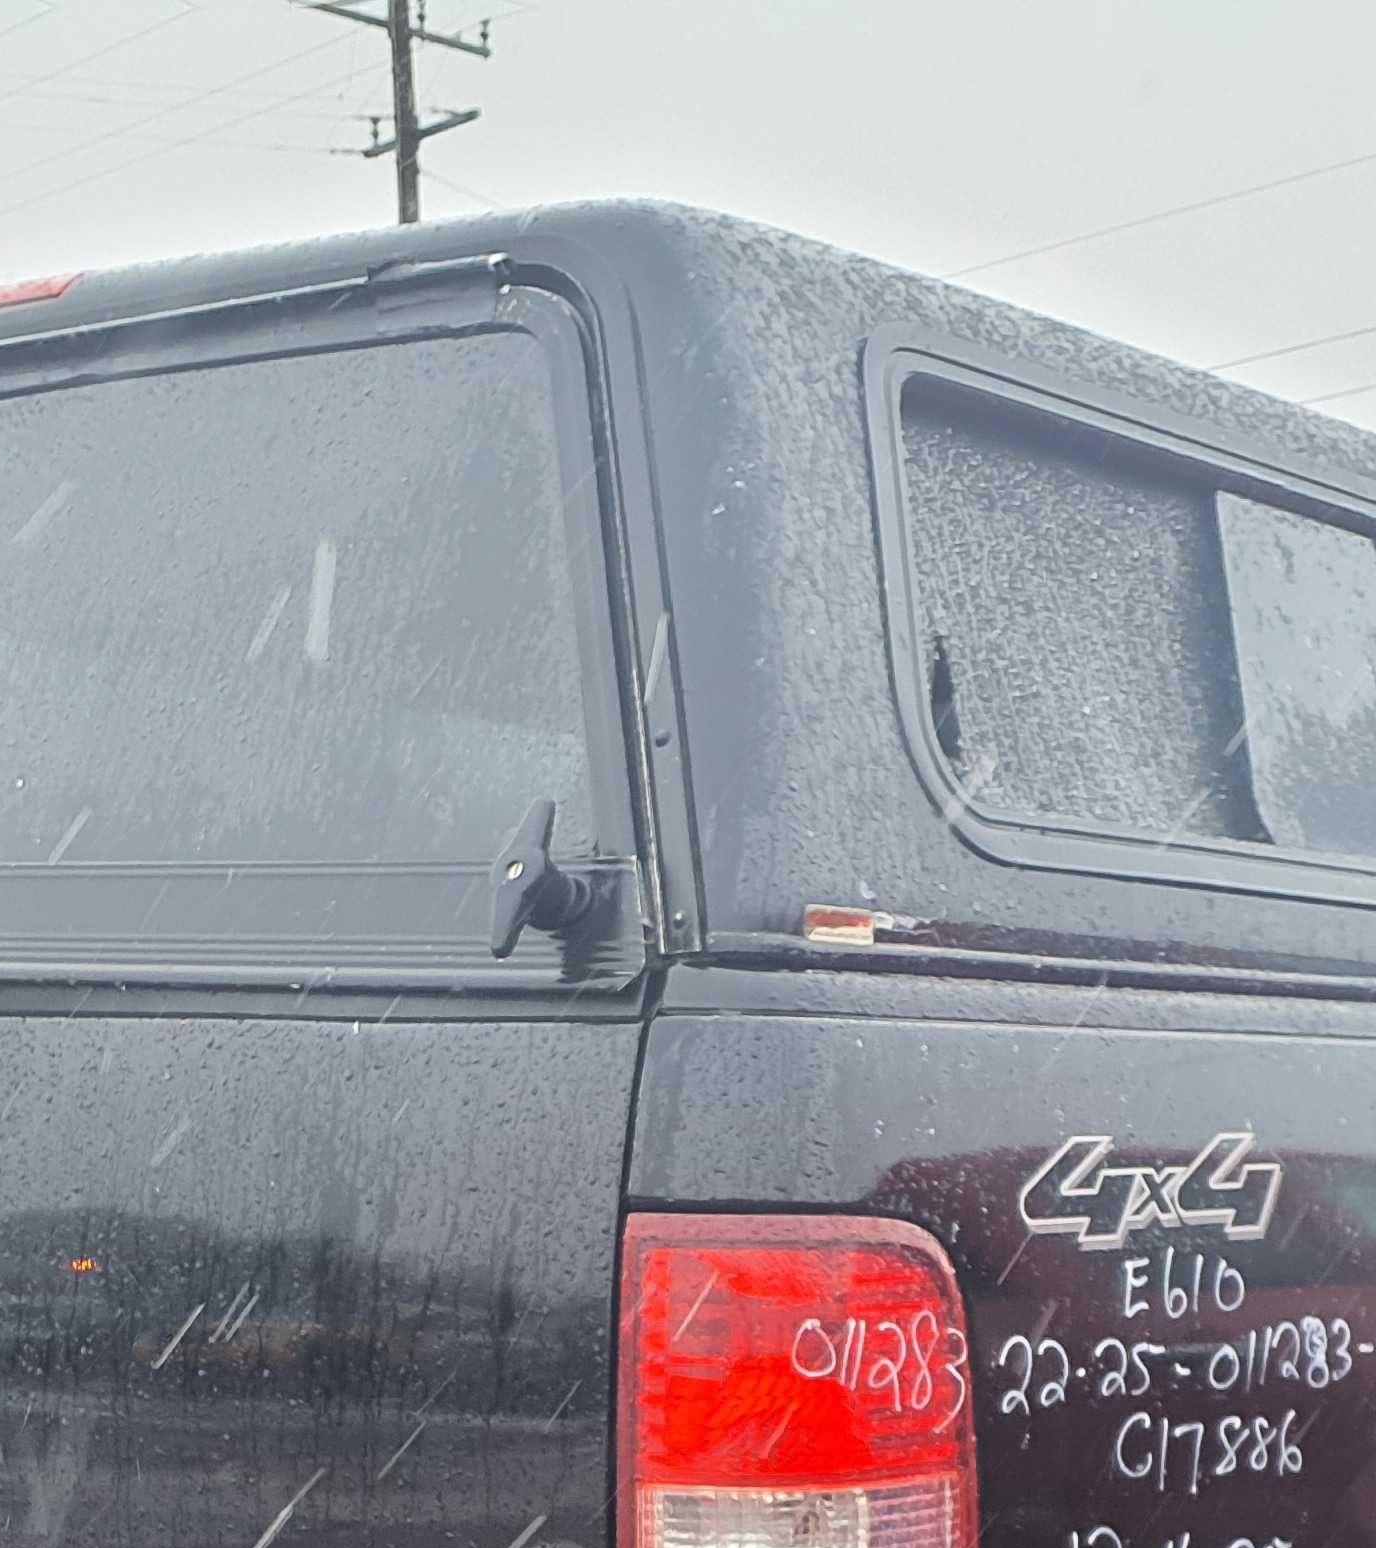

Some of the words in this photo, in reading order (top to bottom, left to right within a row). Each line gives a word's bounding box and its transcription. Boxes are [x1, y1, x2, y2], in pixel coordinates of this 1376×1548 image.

[1023, 1133, 1281, 1250] 4x4
[1124, 1247, 1244, 1319] E610
[791, 1310, 967, 1433] 011283
[1117, 1411, 1303, 1495] C17886
